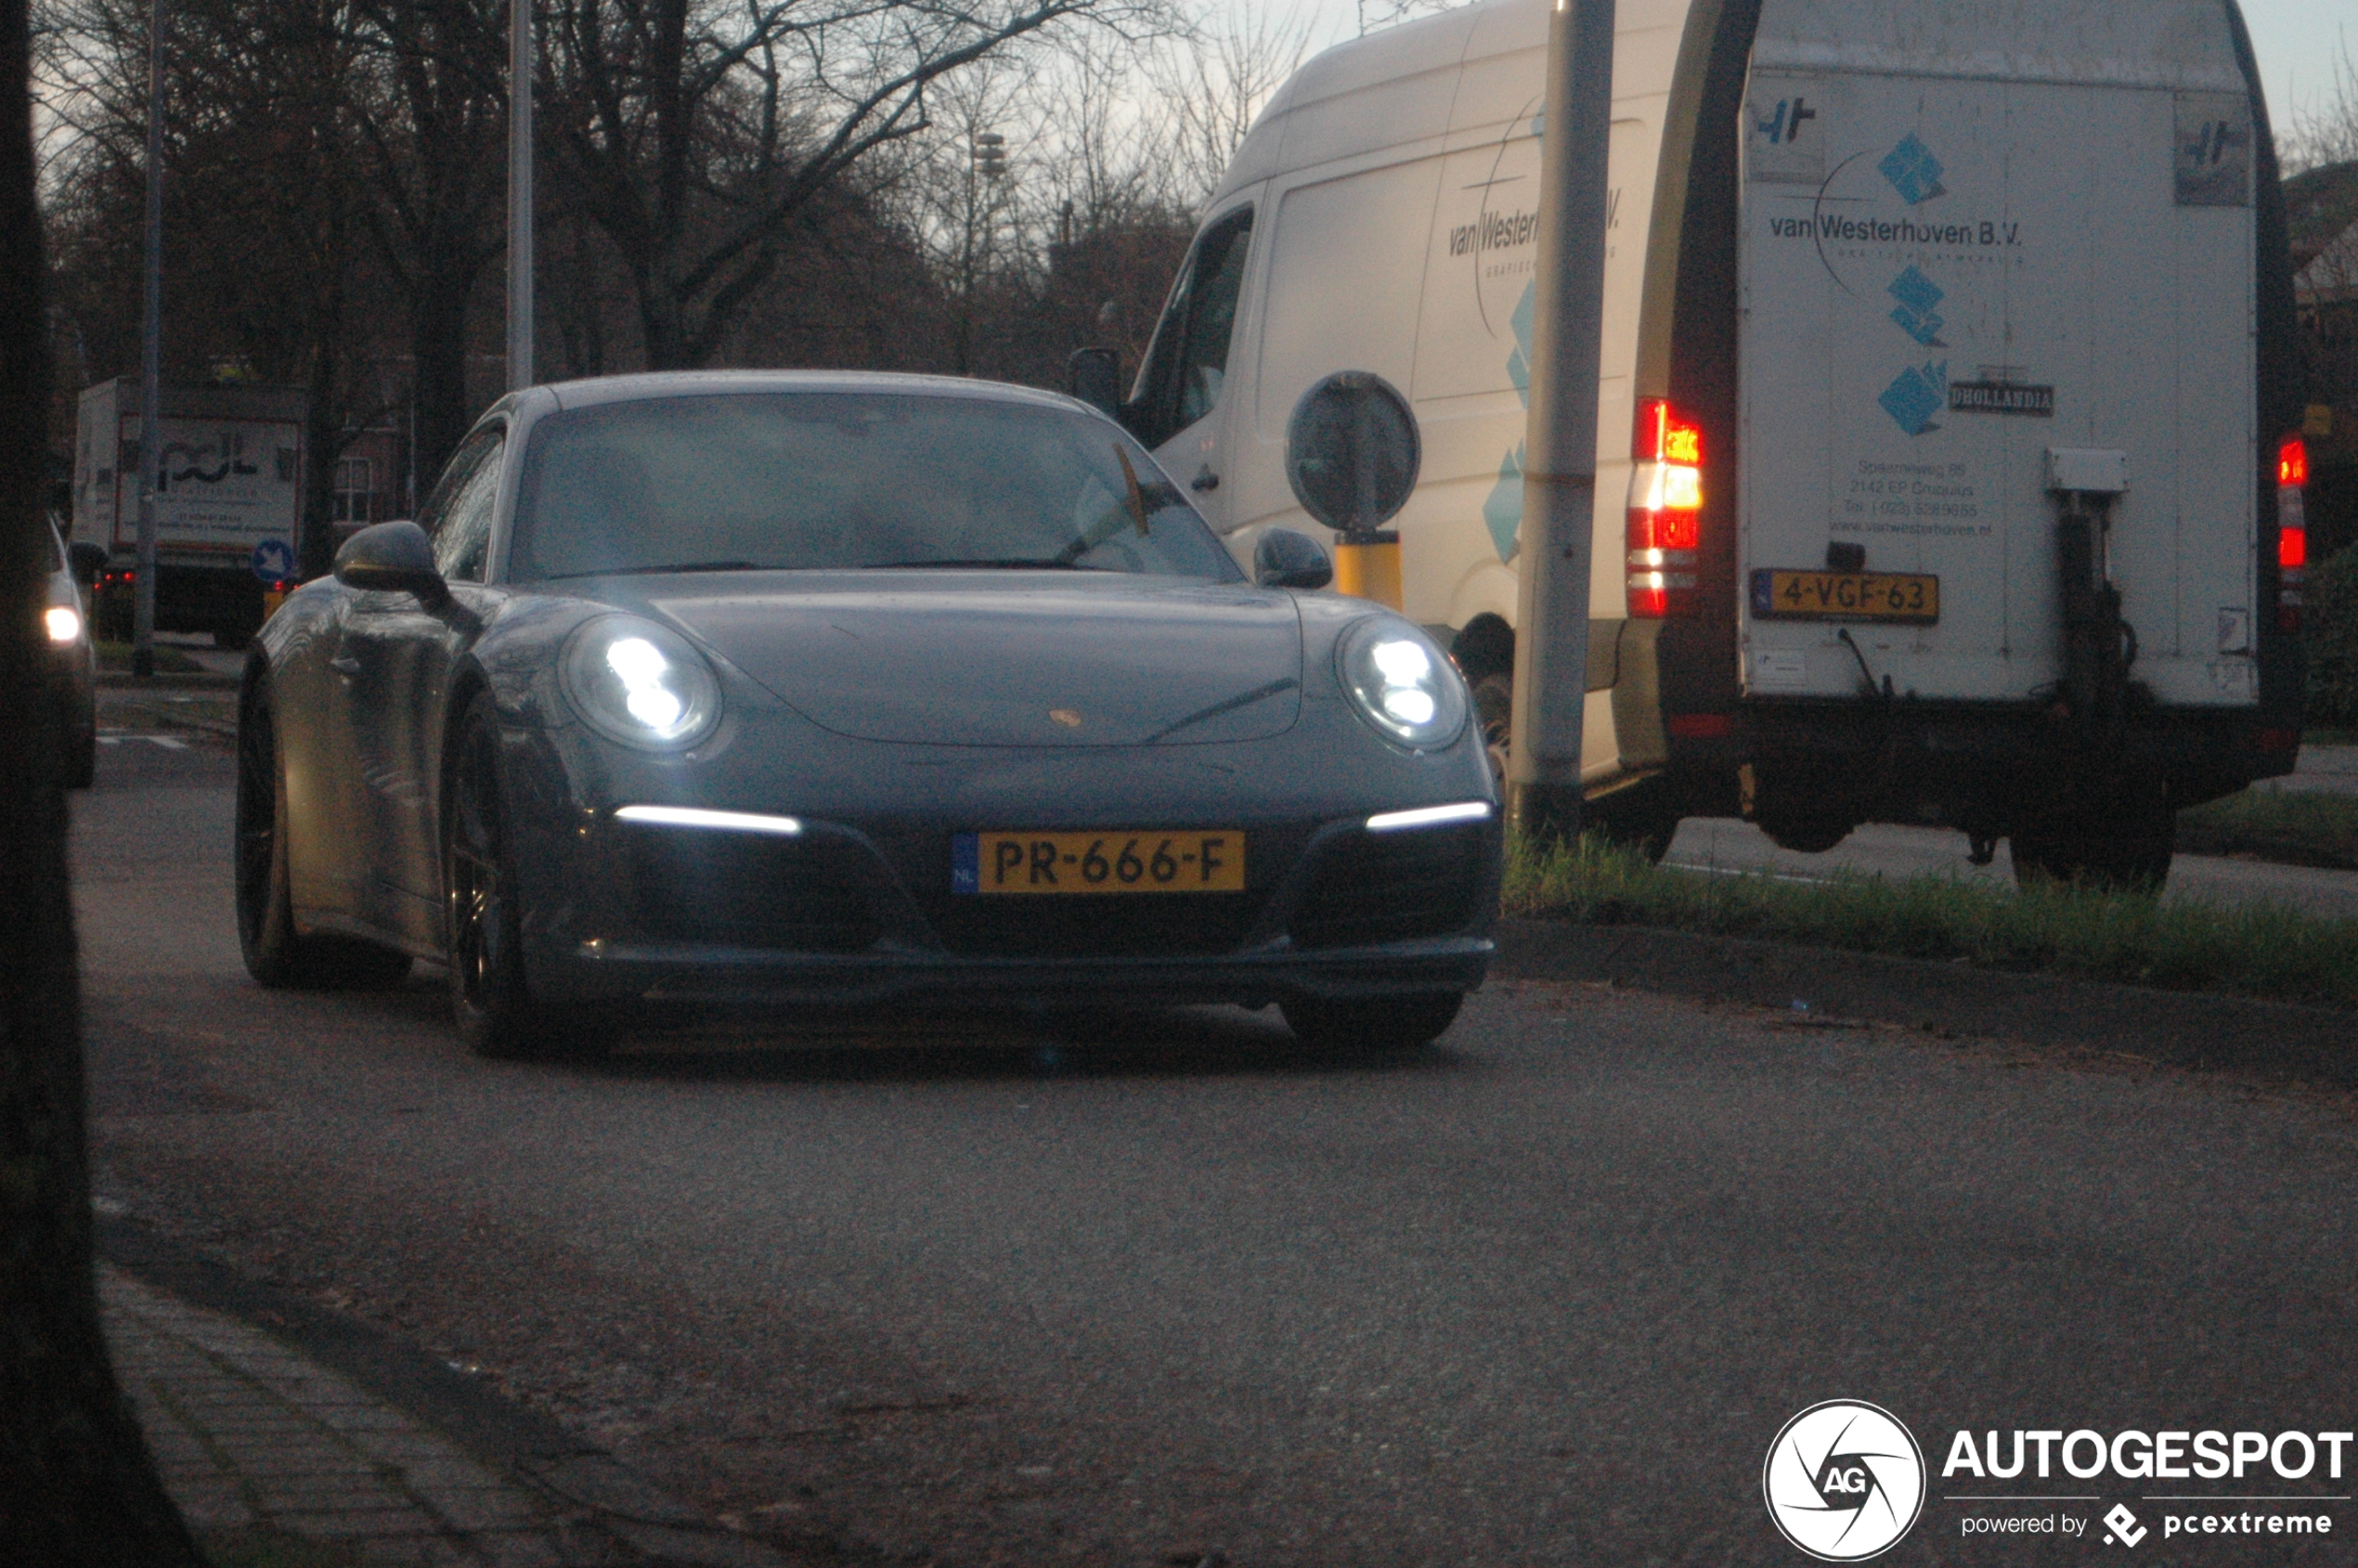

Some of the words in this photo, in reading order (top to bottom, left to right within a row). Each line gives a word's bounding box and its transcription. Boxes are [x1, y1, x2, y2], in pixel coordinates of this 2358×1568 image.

[1450, 223, 1477, 256] van
[1769, 217, 1811, 239] van
[1819, 214, 1972, 244] Westerhoven
[1979, 222, 2022, 247] B.V.
[1952, 387, 2052, 408] DHOLLANDIA
[1850, 479, 1884, 494] 2142
[1783, 576, 1924, 610] 4-VGF-63
[953, 868, 974, 883] NL
[994, 837, 1224, 886] PR-666-F
